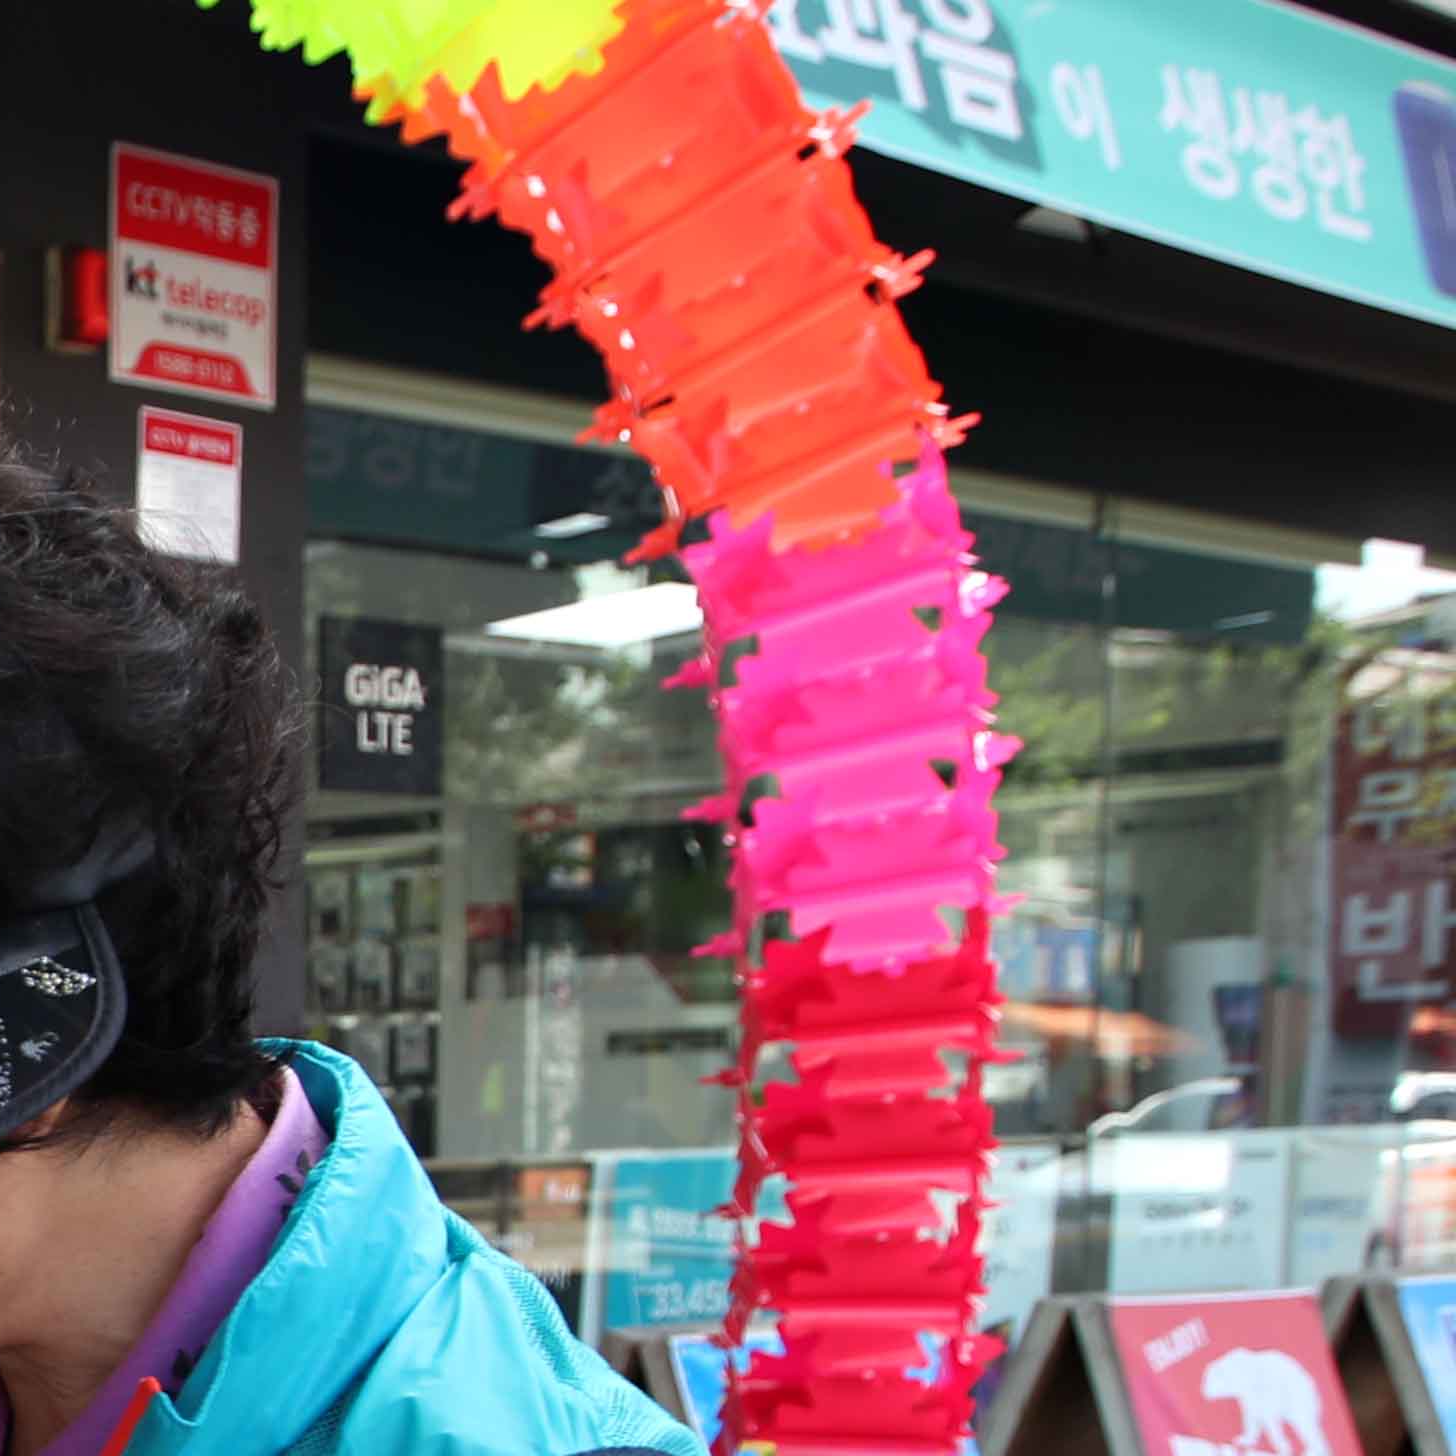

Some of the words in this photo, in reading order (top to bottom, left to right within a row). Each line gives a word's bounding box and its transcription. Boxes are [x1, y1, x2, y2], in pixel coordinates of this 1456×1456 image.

[1160, 63, 1374, 240] 생생한
[126, 257, 157, 299] kt
[165, 276, 266, 327] telecop
[357, 710, 415, 754] LTE
